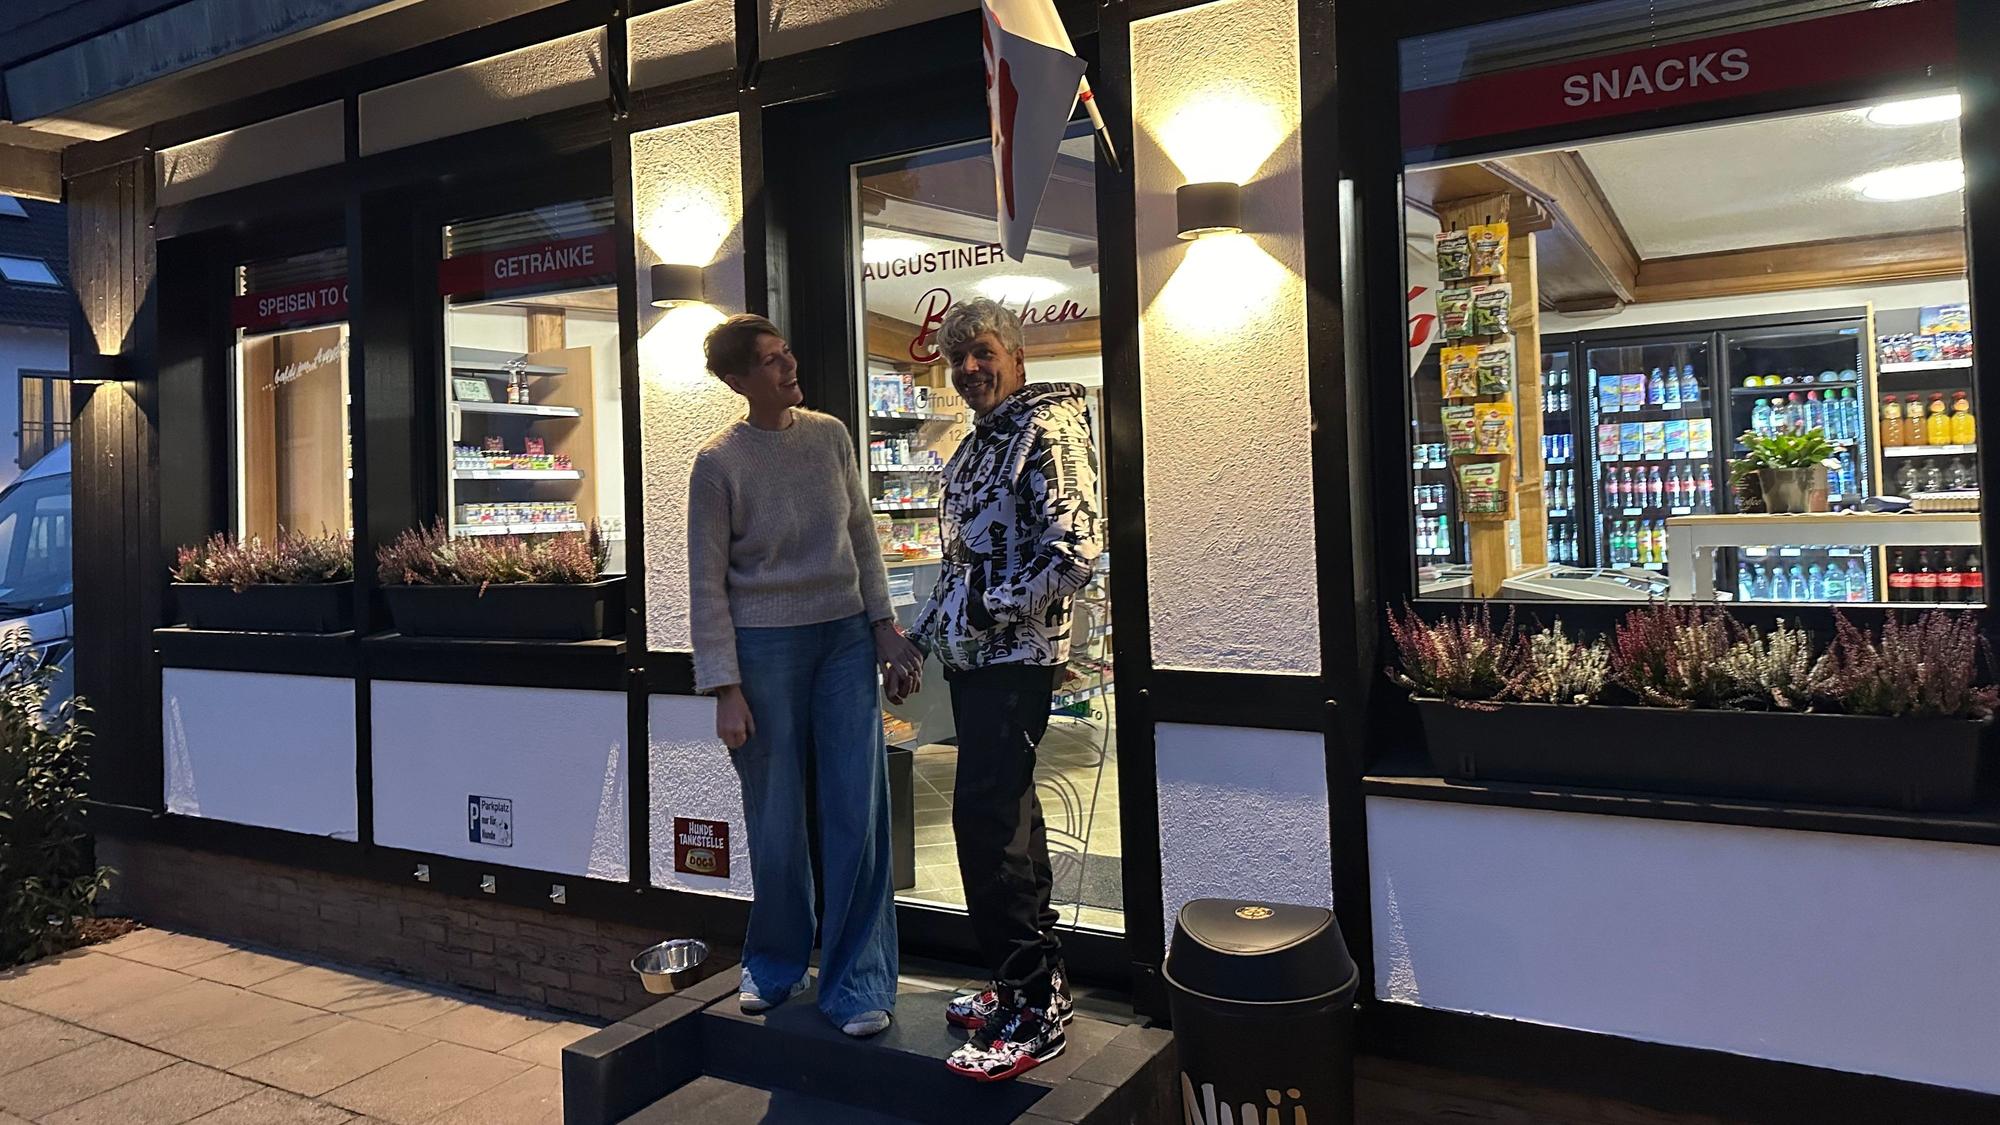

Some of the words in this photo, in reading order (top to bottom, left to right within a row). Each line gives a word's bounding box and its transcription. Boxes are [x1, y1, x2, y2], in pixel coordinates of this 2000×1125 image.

[1563, 48, 1750, 107] SNACKS
[494, 245, 595, 279] GETRÄNKE
[862, 243, 1005, 281] AUGUSTINER
[258, 291, 317, 317] SPEISEN
[319, 287, 339, 307] TO
[909, 287, 1088, 363] Bhen
[470, 802, 479, 830] P
[481, 800, 510, 813] Parkplatz
[481, 829, 496, 840] Hunde
[678, 832, 725, 849] TANKSTELLE
[688, 821, 714, 836] HUNDE
